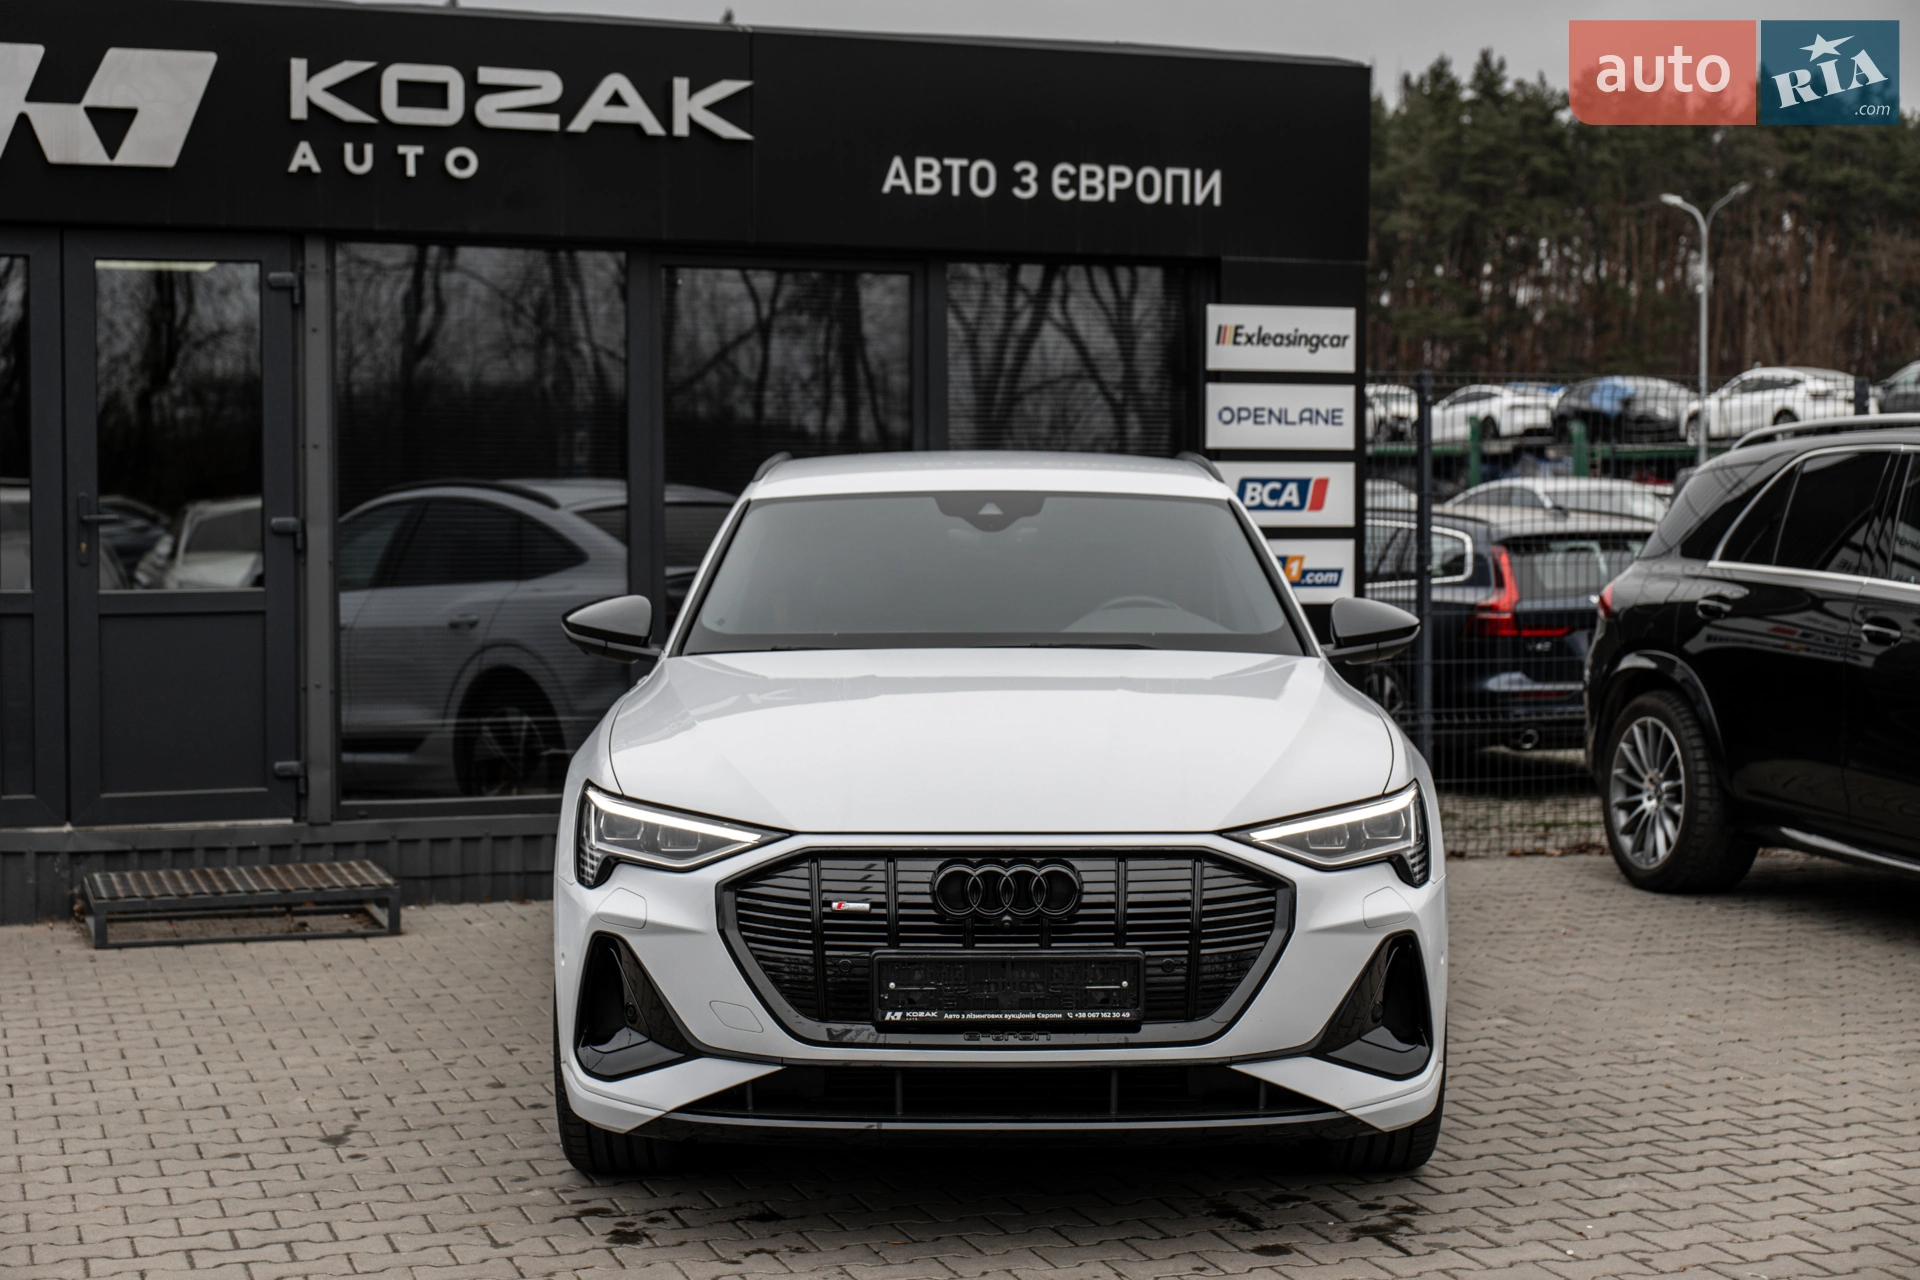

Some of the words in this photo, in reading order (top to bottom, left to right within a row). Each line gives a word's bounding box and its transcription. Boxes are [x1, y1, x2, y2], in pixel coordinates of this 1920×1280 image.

[290, 57, 755, 140] KOZAK
[288, 140, 479, 179] AUTO
[882, 156, 997, 198] АВТО
[1012, 161, 1039, 199] З
[1051, 163, 1222, 207] ЄВРОПИ
[1232, 323, 1350, 354] Exleasingcar
[1217, 406, 1344, 427] OPENLANE
[1243, 481, 1301, 508] BCA
[963, 1030, 1051, 1041] e-tron
